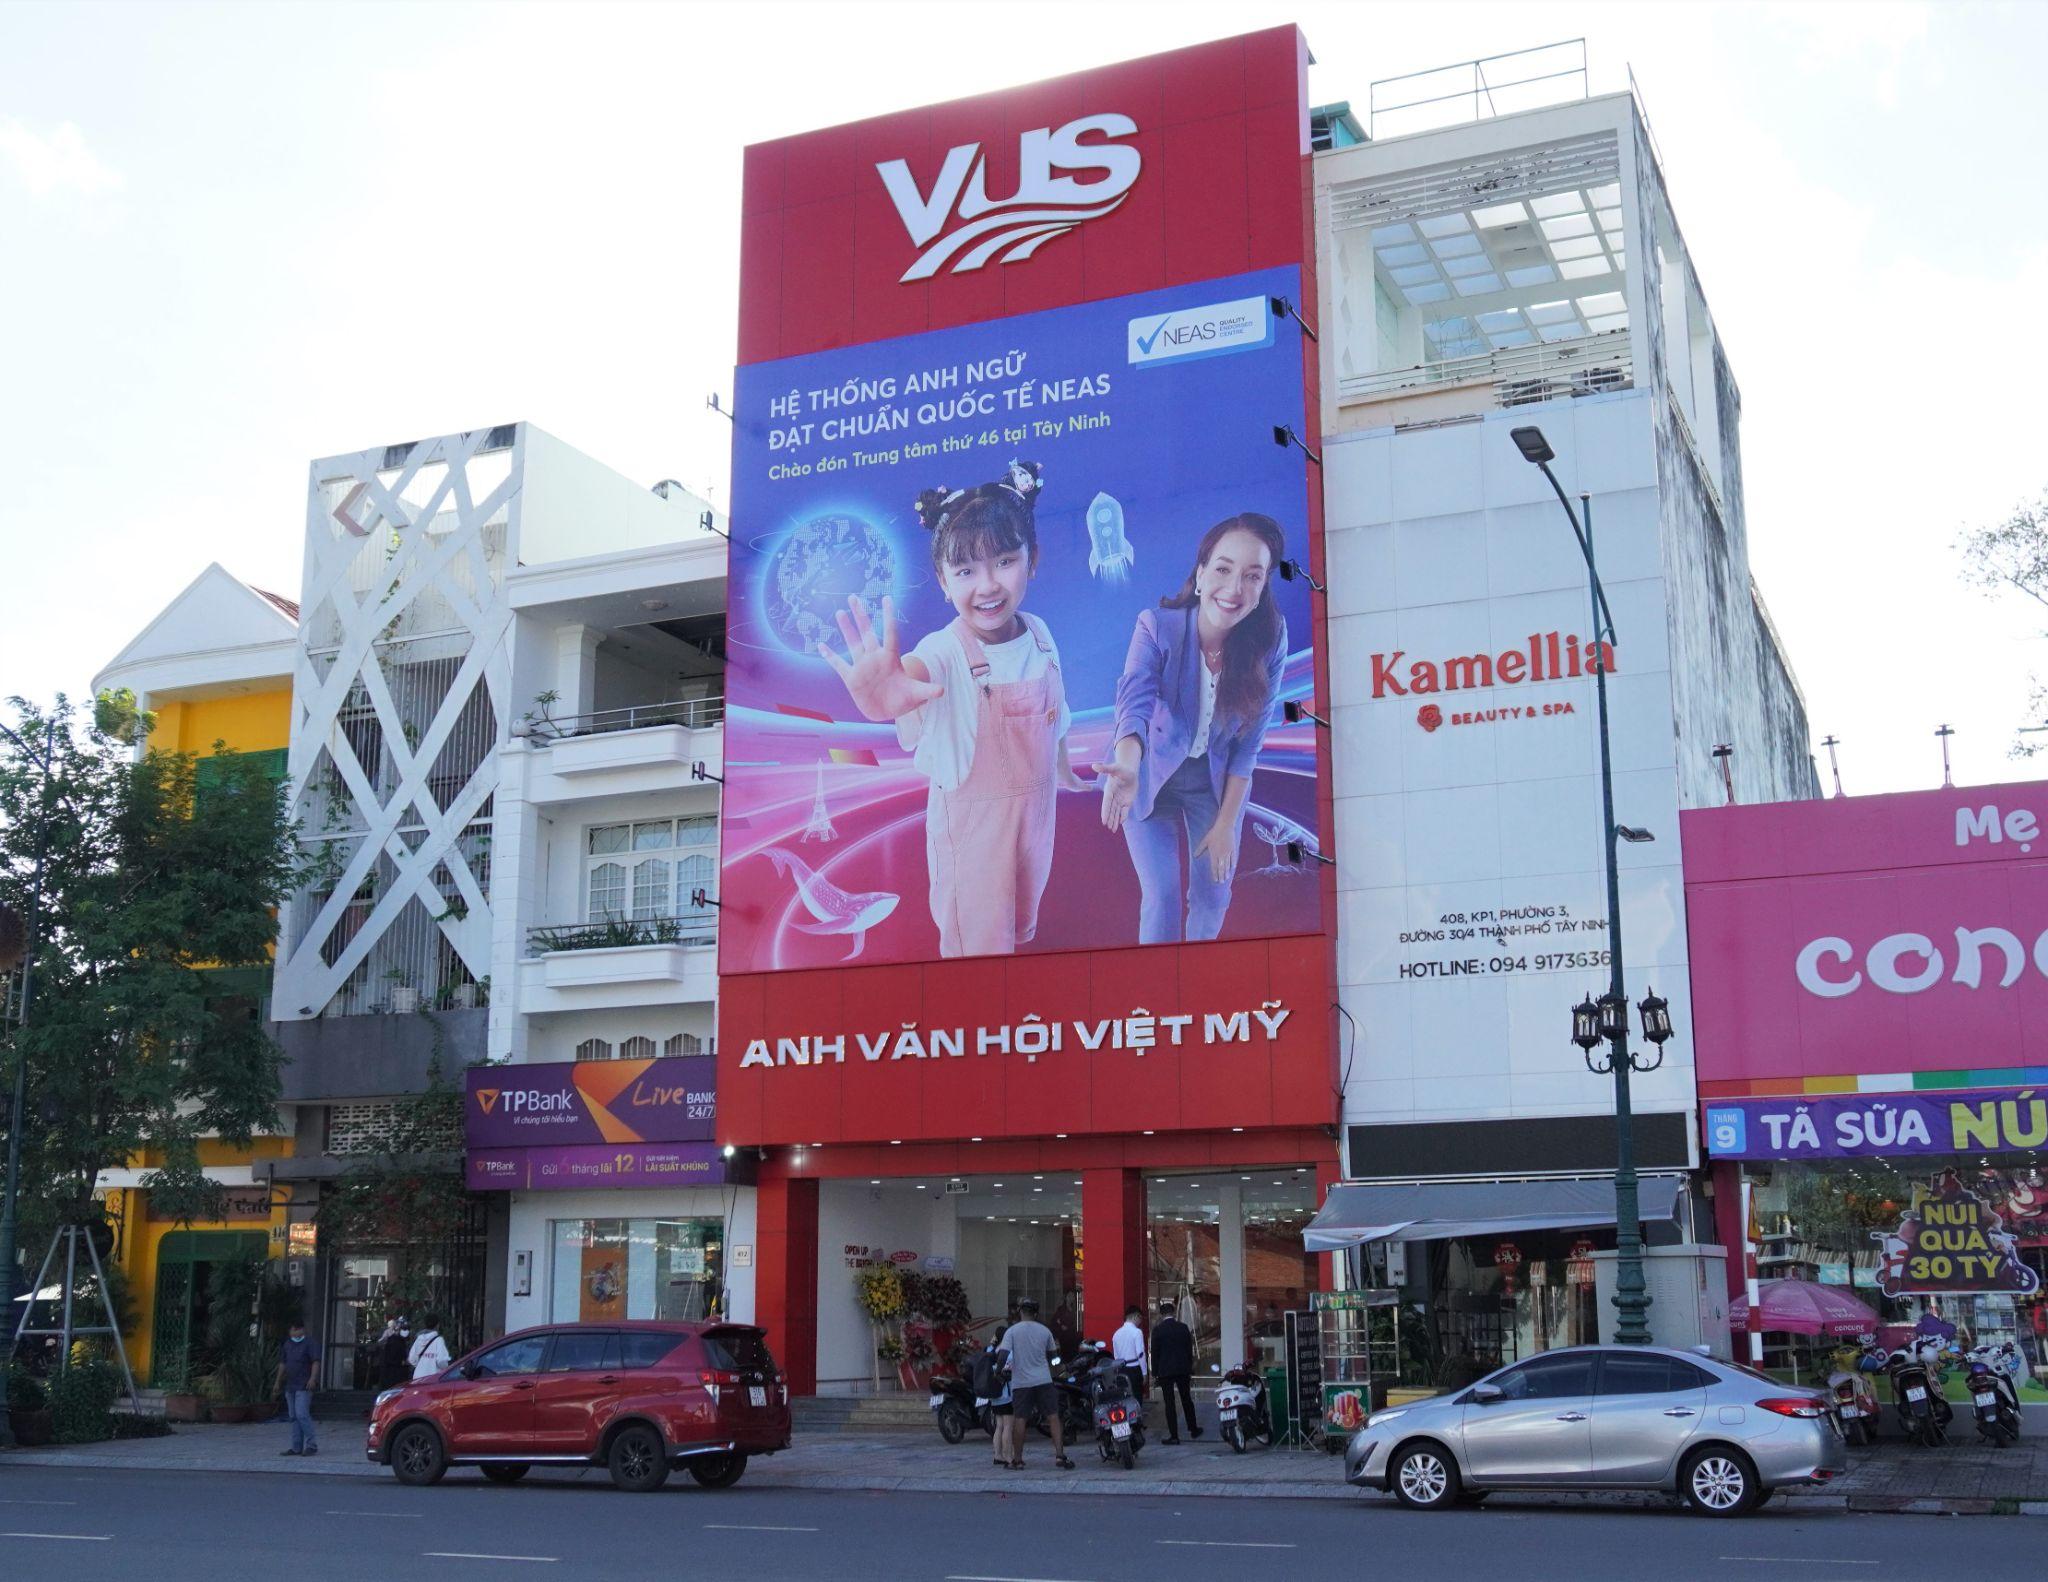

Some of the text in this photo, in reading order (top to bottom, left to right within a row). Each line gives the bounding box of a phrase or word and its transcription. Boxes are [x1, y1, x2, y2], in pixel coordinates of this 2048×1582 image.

[875, 113, 1141, 249] VUS
[1164, 322, 1216, 347] NEAS
[1220, 316, 1246, 326] QUALITY
[769, 349, 1027, 421] HỆ THỐNG ANH NGỮ
[768, 373, 1112, 453] ĐẠT CHUẨN QUỐC TẾ NEAS
[768, 411, 1112, 480] Chào đón Trung tâm thứ 46 tại Tây Ninh
[1370, 631, 1618, 699] Kamellia
[1451, 702, 1575, 726] BEAUTY & SPA
[1955, 804, 2041, 853] Mẹ
[1440, 905, 1570, 925] 408, KP1, PHƯỜNG 3,
[1399, 928, 1445, 944] ĐƯỜNG
[1449, 928, 1475, 941] 30/4
[1479, 924, 1521, 939] THÀNH
[1524, 920, 1551, 935] PHỐ
[1555, 920, 1578, 934] TÂY
[1399, 950, 1612, 978] HOTLINE: 094 9173636
[1795, 926, 2048, 998] con
[740, 999, 1292, 1068] ANH VĂN HỘI VIỆT MỸ
[502, 1081, 716, 1112] TPBank Live BANK
[688, 1105, 714, 1119] 24/7
[1713, 1111, 1738, 1125] THÁNG
[1760, 1106, 1820, 1150] TÃ
[1835, 1103, 1932, 1148] SỮA
[1716, 1126, 1737, 1148] 9
[486, 1161, 515, 1171] TPBank
[571, 1162, 599, 1176] tháng
[614, 1153, 635, 1173] 12
[658, 1160, 680, 1171] SUẤT
[1924, 1200, 1978, 1225] NÚI
[1919, 1226, 1989, 1252] QUÀ
[1909, 1252, 2002, 1279] 30 TỶ
